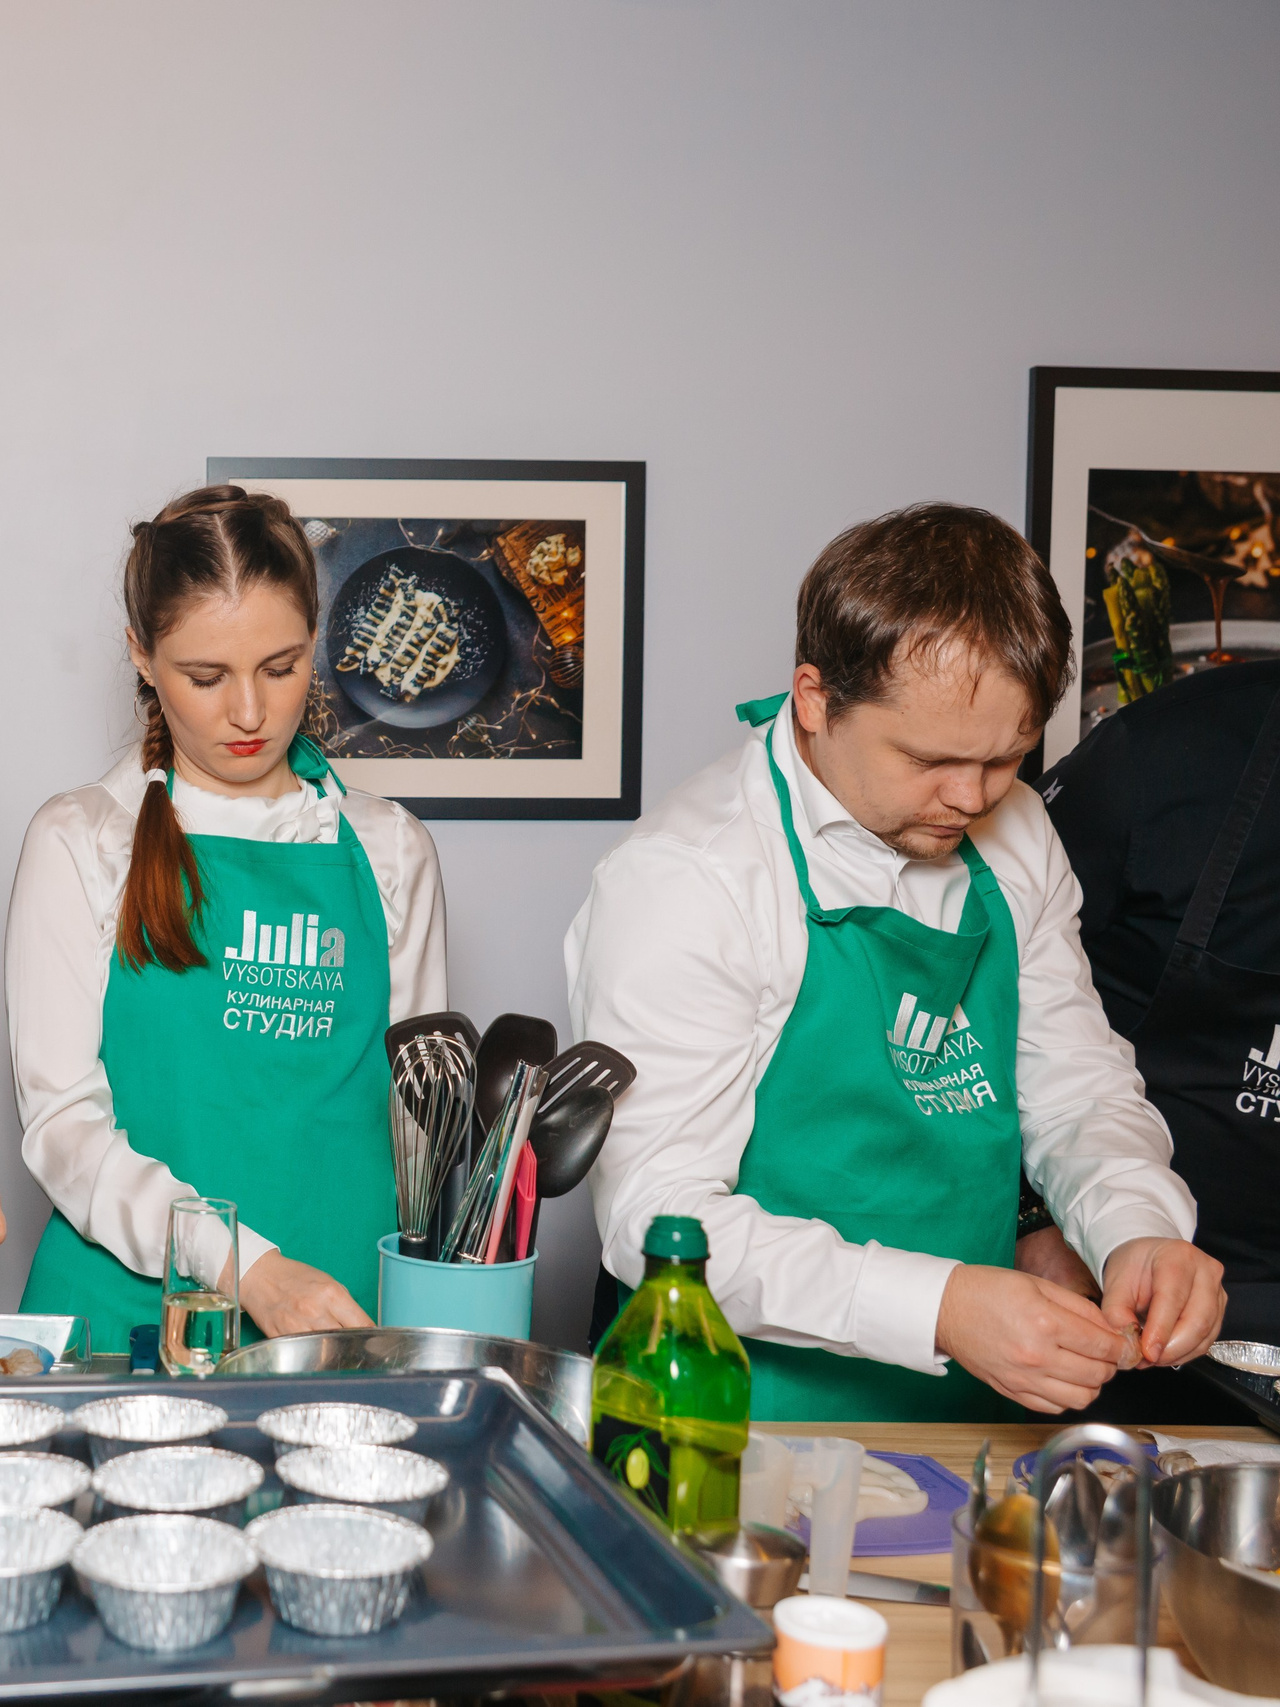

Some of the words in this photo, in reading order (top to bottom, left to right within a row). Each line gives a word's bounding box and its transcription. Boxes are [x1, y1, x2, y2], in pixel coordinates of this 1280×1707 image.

[224, 909, 346, 968] Julia
[222, 961, 344, 992] VYSOTSKAYA
[226, 990, 335, 1013] КУЛИНАРНАЯ
[223, 1007, 333, 1041] СТУДИЯ
[914, 1080, 998, 1116] СТУДИЯ
